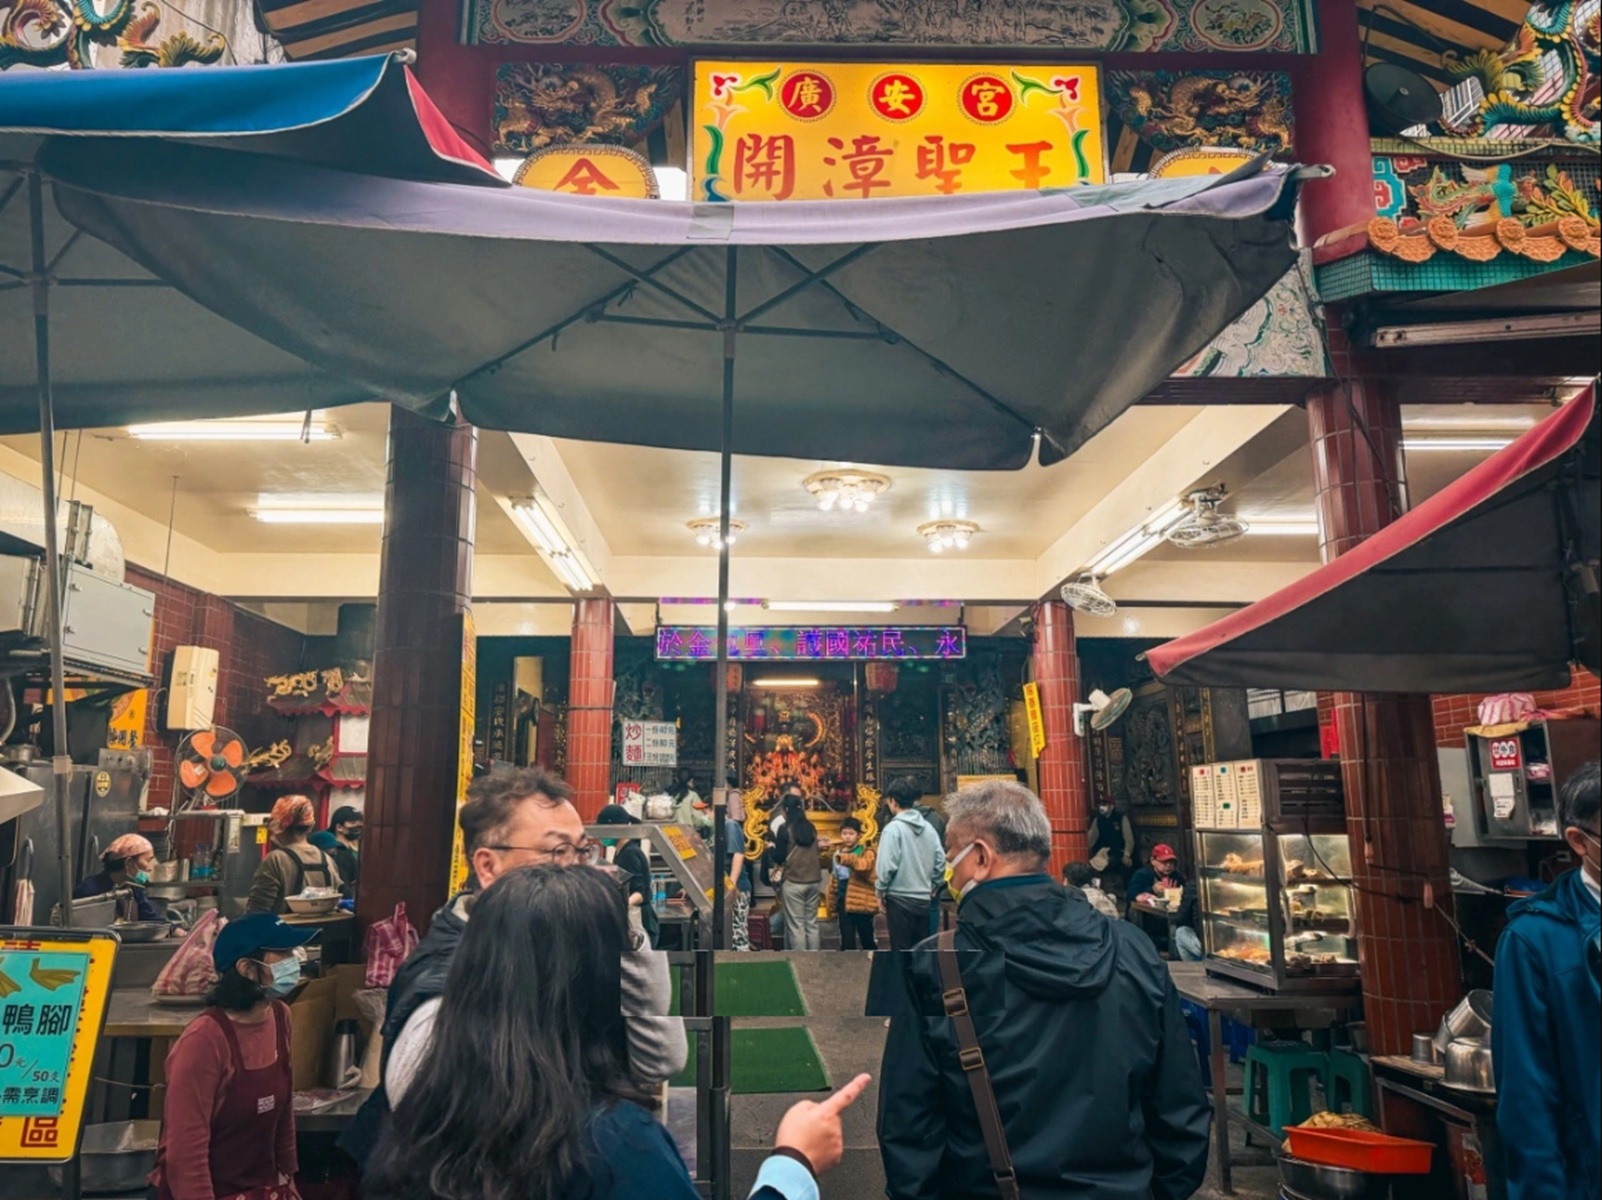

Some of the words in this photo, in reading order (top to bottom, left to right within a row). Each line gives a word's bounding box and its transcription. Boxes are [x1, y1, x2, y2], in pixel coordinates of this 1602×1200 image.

[786, 75, 1005, 118] 廣安宮
[733, 132, 1054, 200] 開漳聖王
[625, 722, 642, 762] 炒麵
[2, 1003, 73, 1036] 鴨腳
[2, 1086, 59, 1105] 需烹調
